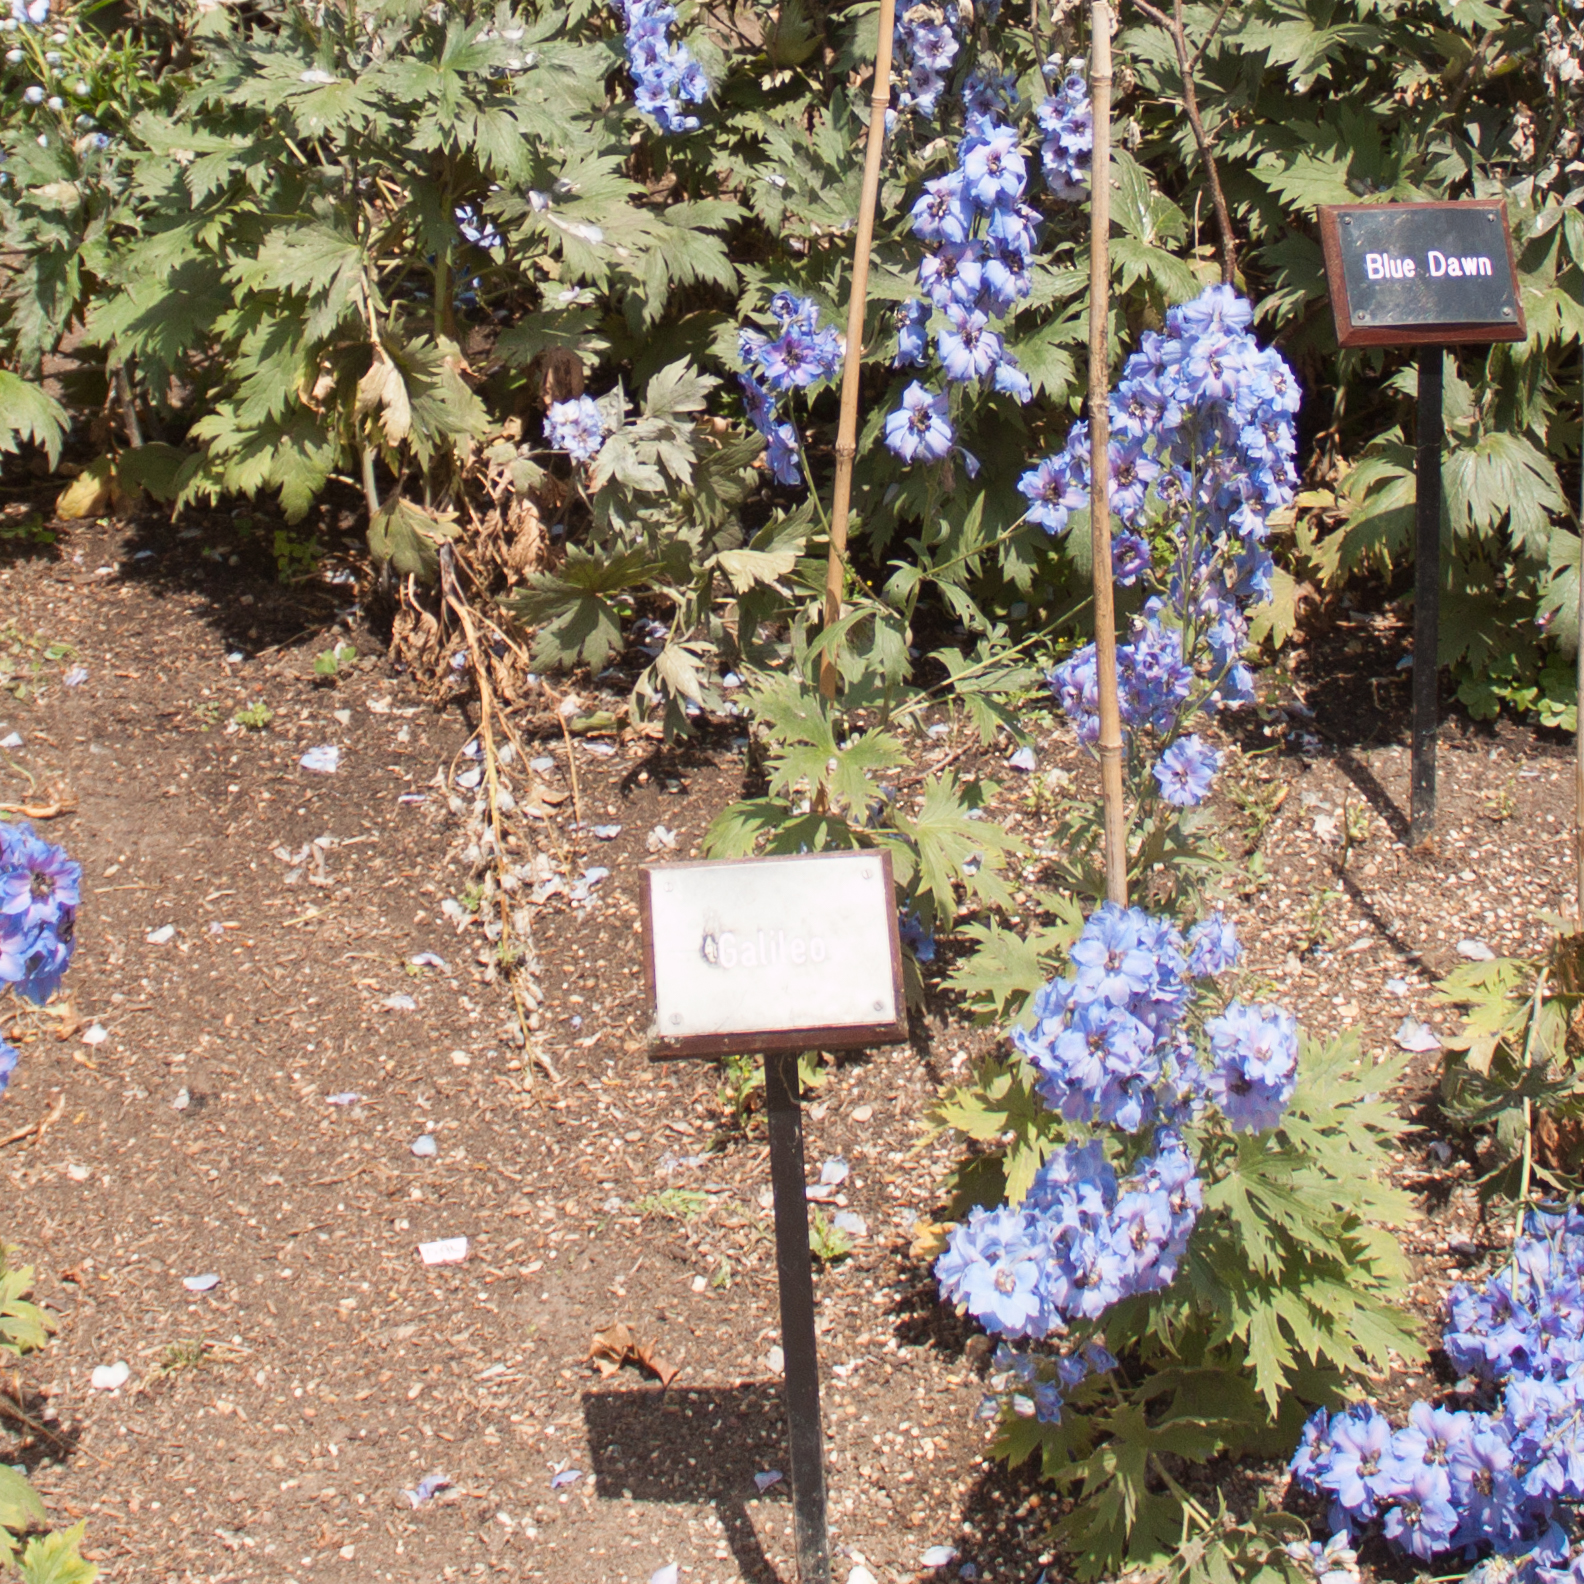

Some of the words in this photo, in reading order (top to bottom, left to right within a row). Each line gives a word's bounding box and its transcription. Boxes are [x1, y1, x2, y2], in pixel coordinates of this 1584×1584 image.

[1365, 253, 1416, 280] Blue
[1428, 250, 1493, 278] Dawn
[718, 929, 827, 969] Galileo
